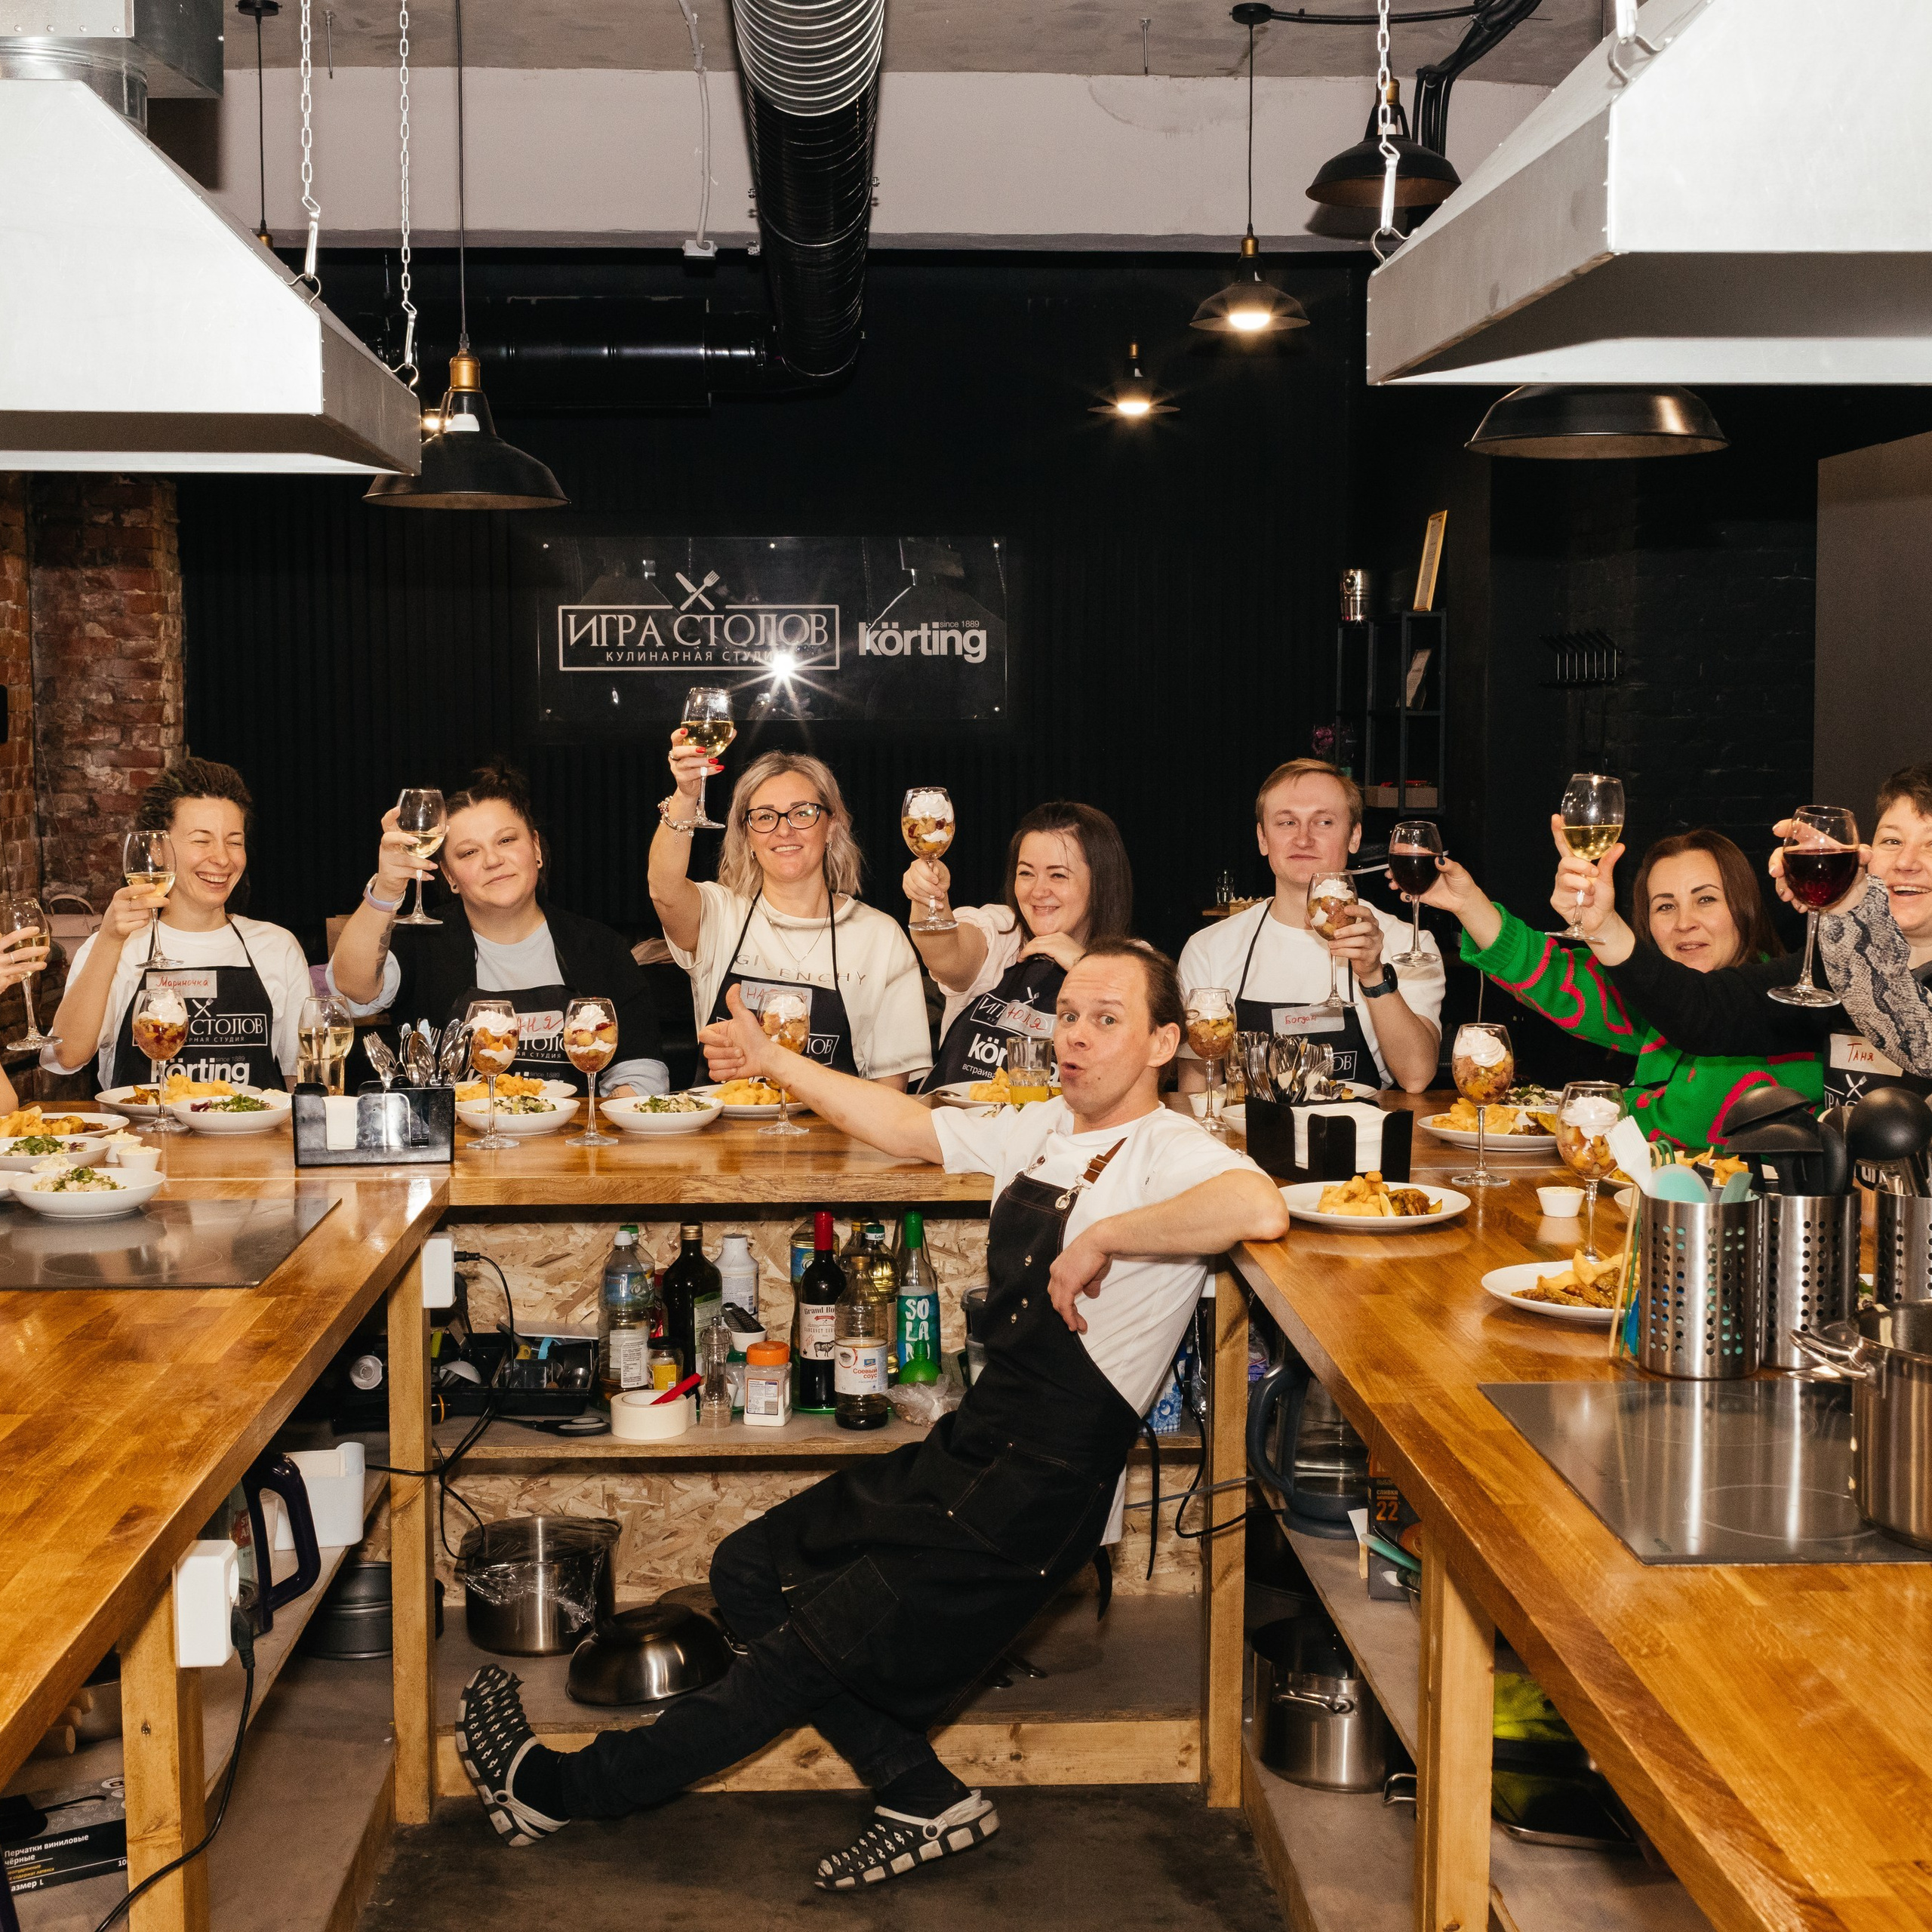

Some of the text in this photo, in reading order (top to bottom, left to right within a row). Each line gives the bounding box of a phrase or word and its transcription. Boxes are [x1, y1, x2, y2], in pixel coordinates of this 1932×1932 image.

[568, 614, 829, 647] ИГРА СТОЛОВ
[858, 622, 987, 663] körting
[606, 651, 776, 662] КУЛИНАРНАЯ СТУДИ
[735, 954, 866, 986] GIVENCHY
[155, 976, 209, 989] Мариночка
[190, 1018, 263, 1035] СТОЛОВ
[804, 1306, 823, 1315] Grand
[905, 1298, 930, 1321] SO
[905, 1321, 930, 1342] LA
[1376, 1500, 1398, 1521] 22
[5, 1834, 89, 1857] Перчатки виниловые
[5, 1854, 35, 1866] чёрные
[11, 1880, 37, 1892] азмер
